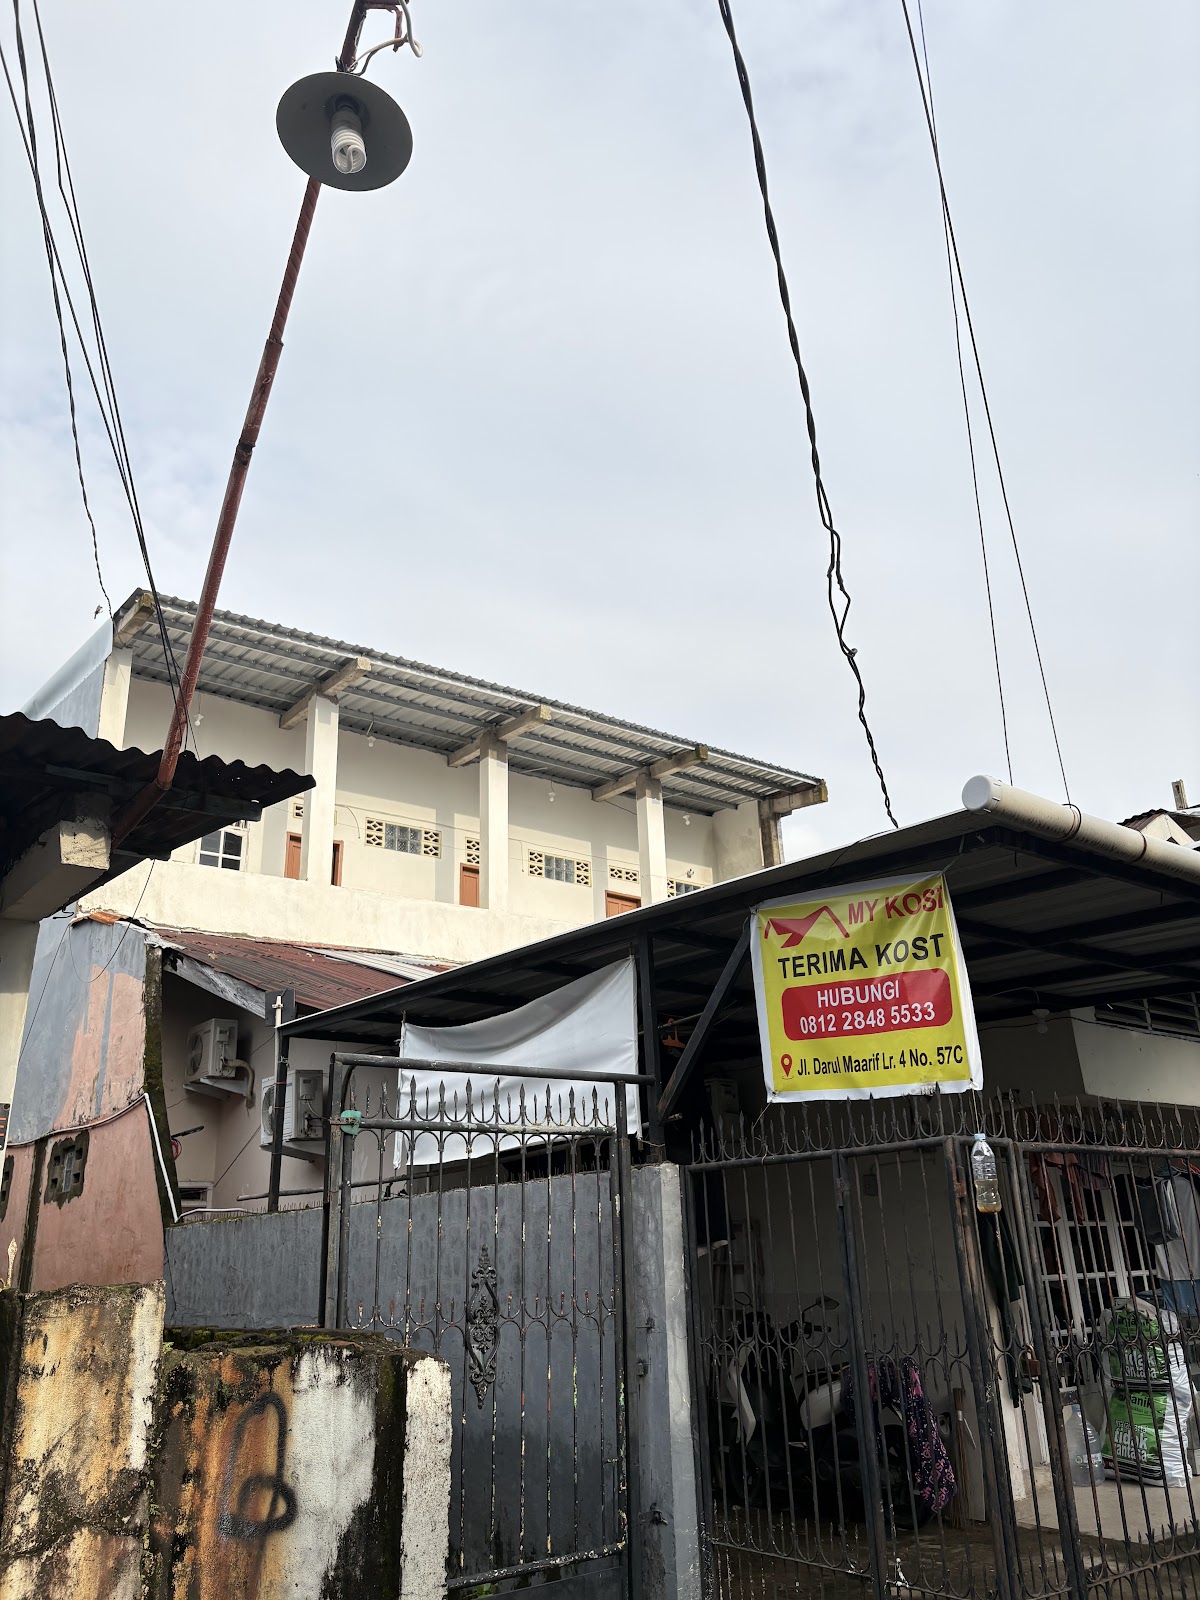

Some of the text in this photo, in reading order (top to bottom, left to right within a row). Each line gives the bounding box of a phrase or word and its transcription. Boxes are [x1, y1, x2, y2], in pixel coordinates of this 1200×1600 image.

[848, 898, 881, 925] MY
[778, 933, 944, 979] TERIMA KOST
[817, 979, 900, 1008] HUBUNGI
[799, 1001, 936, 1035] 0812 2848 5533
[797, 1044, 964, 1076] Jl. Darul Maarif Lr. 4 No. 57C
